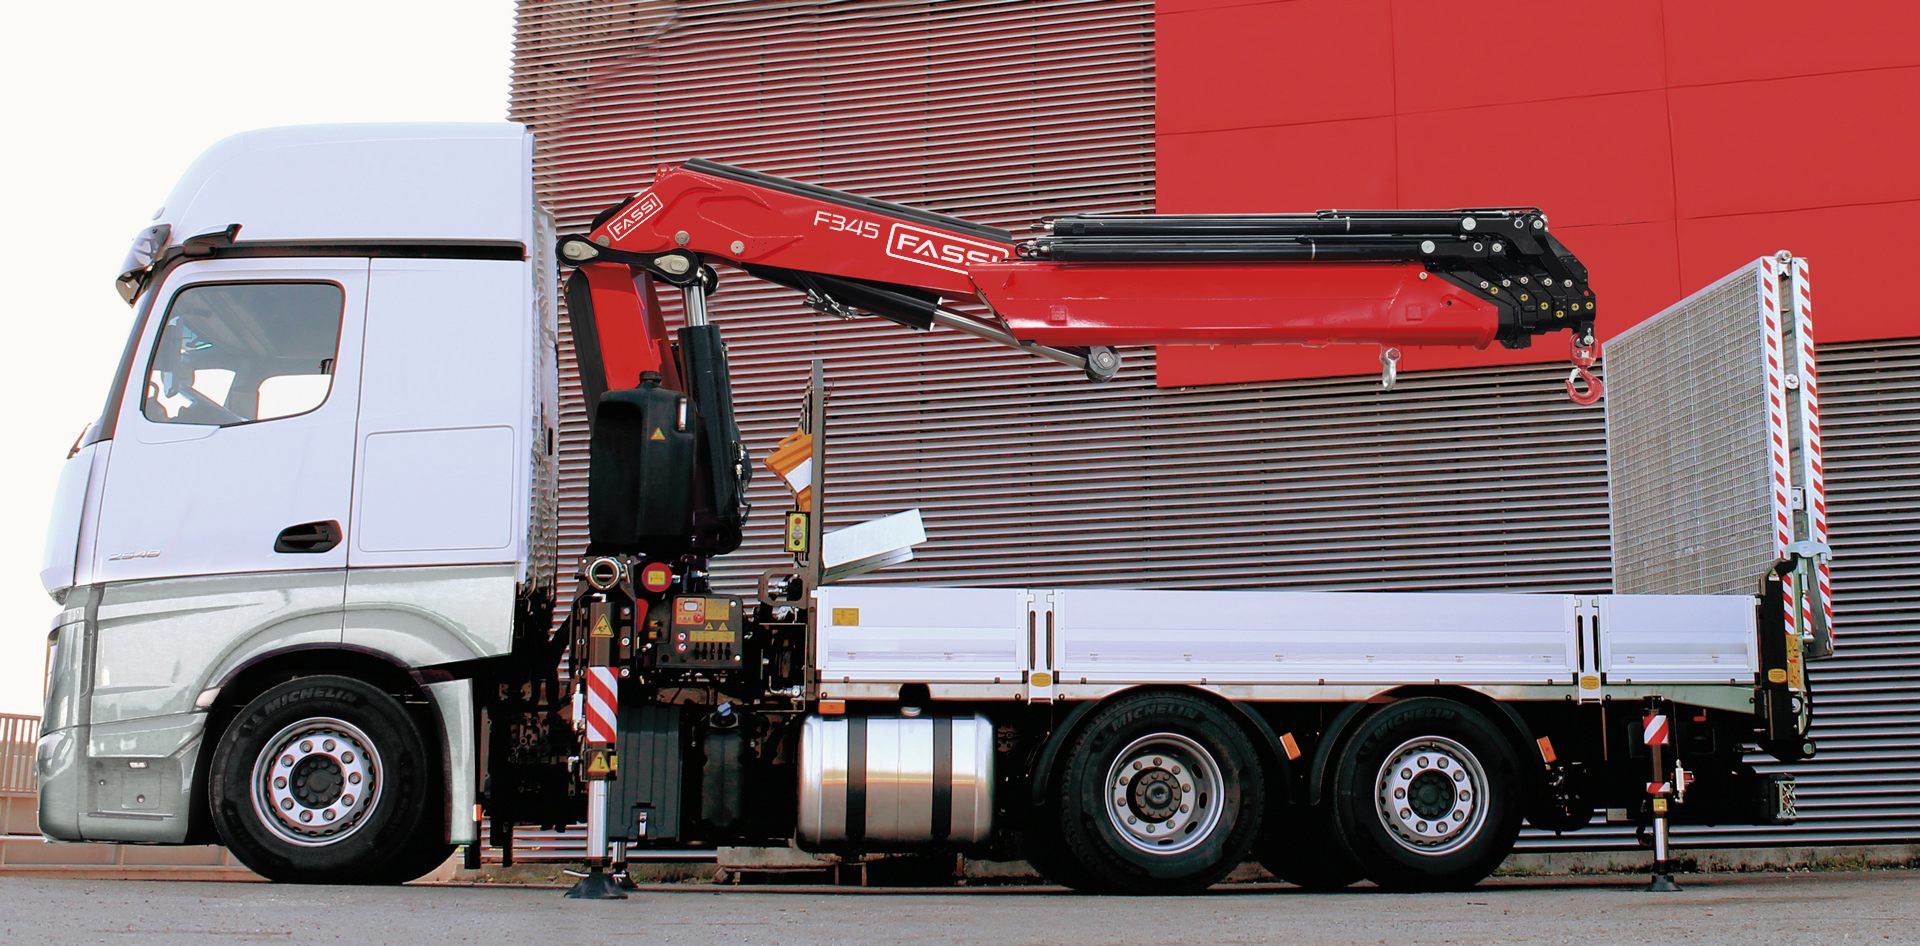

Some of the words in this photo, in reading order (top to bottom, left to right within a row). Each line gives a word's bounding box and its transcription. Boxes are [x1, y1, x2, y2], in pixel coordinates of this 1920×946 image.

[613, 198, 657, 235] FASSI
[813, 210, 880, 239] F345
[264, 686, 358, 716] MICHELIN
[1111, 703, 1200, 732] MICHELIN
[1373, 707, 1456, 740] MICHELIN
